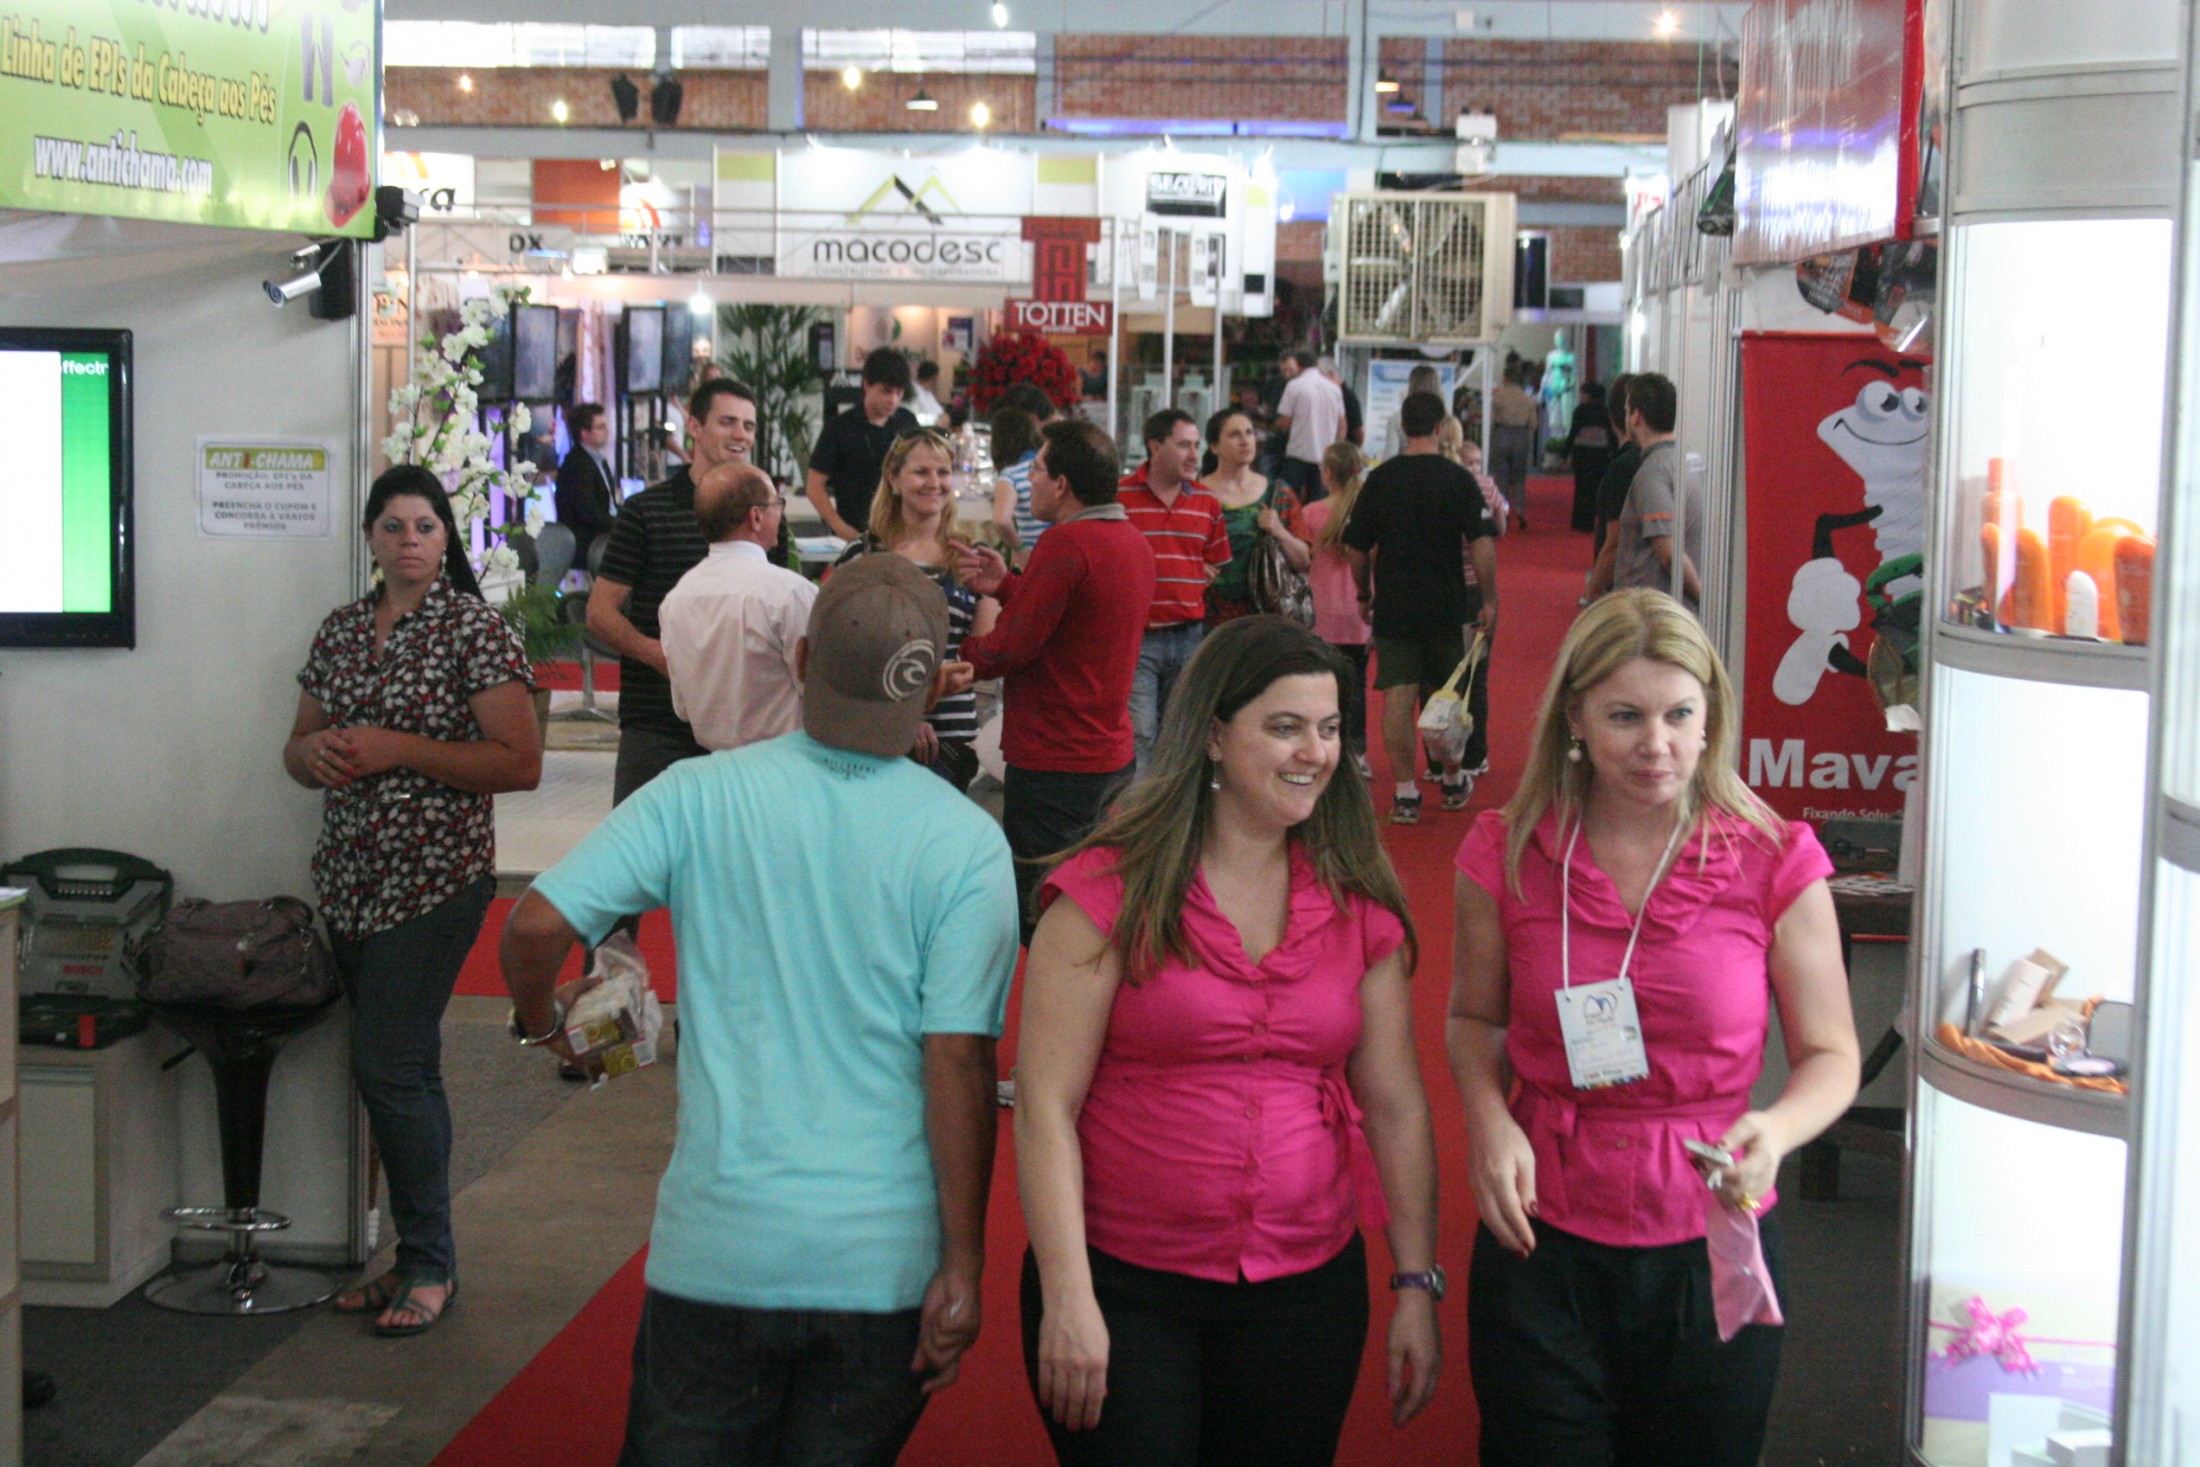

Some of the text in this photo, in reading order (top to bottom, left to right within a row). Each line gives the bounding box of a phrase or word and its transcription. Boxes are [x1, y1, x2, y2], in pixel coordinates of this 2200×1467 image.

[1, 15, 276, 126] Linha de EPIs da Cabeça aos Pés
[34, 129, 213, 195] www.antichama.com
[813, 232, 1001, 264] macodesc
[1015, 301, 1106, 327] TOTTEN
[224, 481, 262, 491] CABEÇA
[264, 481, 283, 490] AOS
[300, 472, 313, 480] DA
[212, 501, 262, 510] PREENCHA
